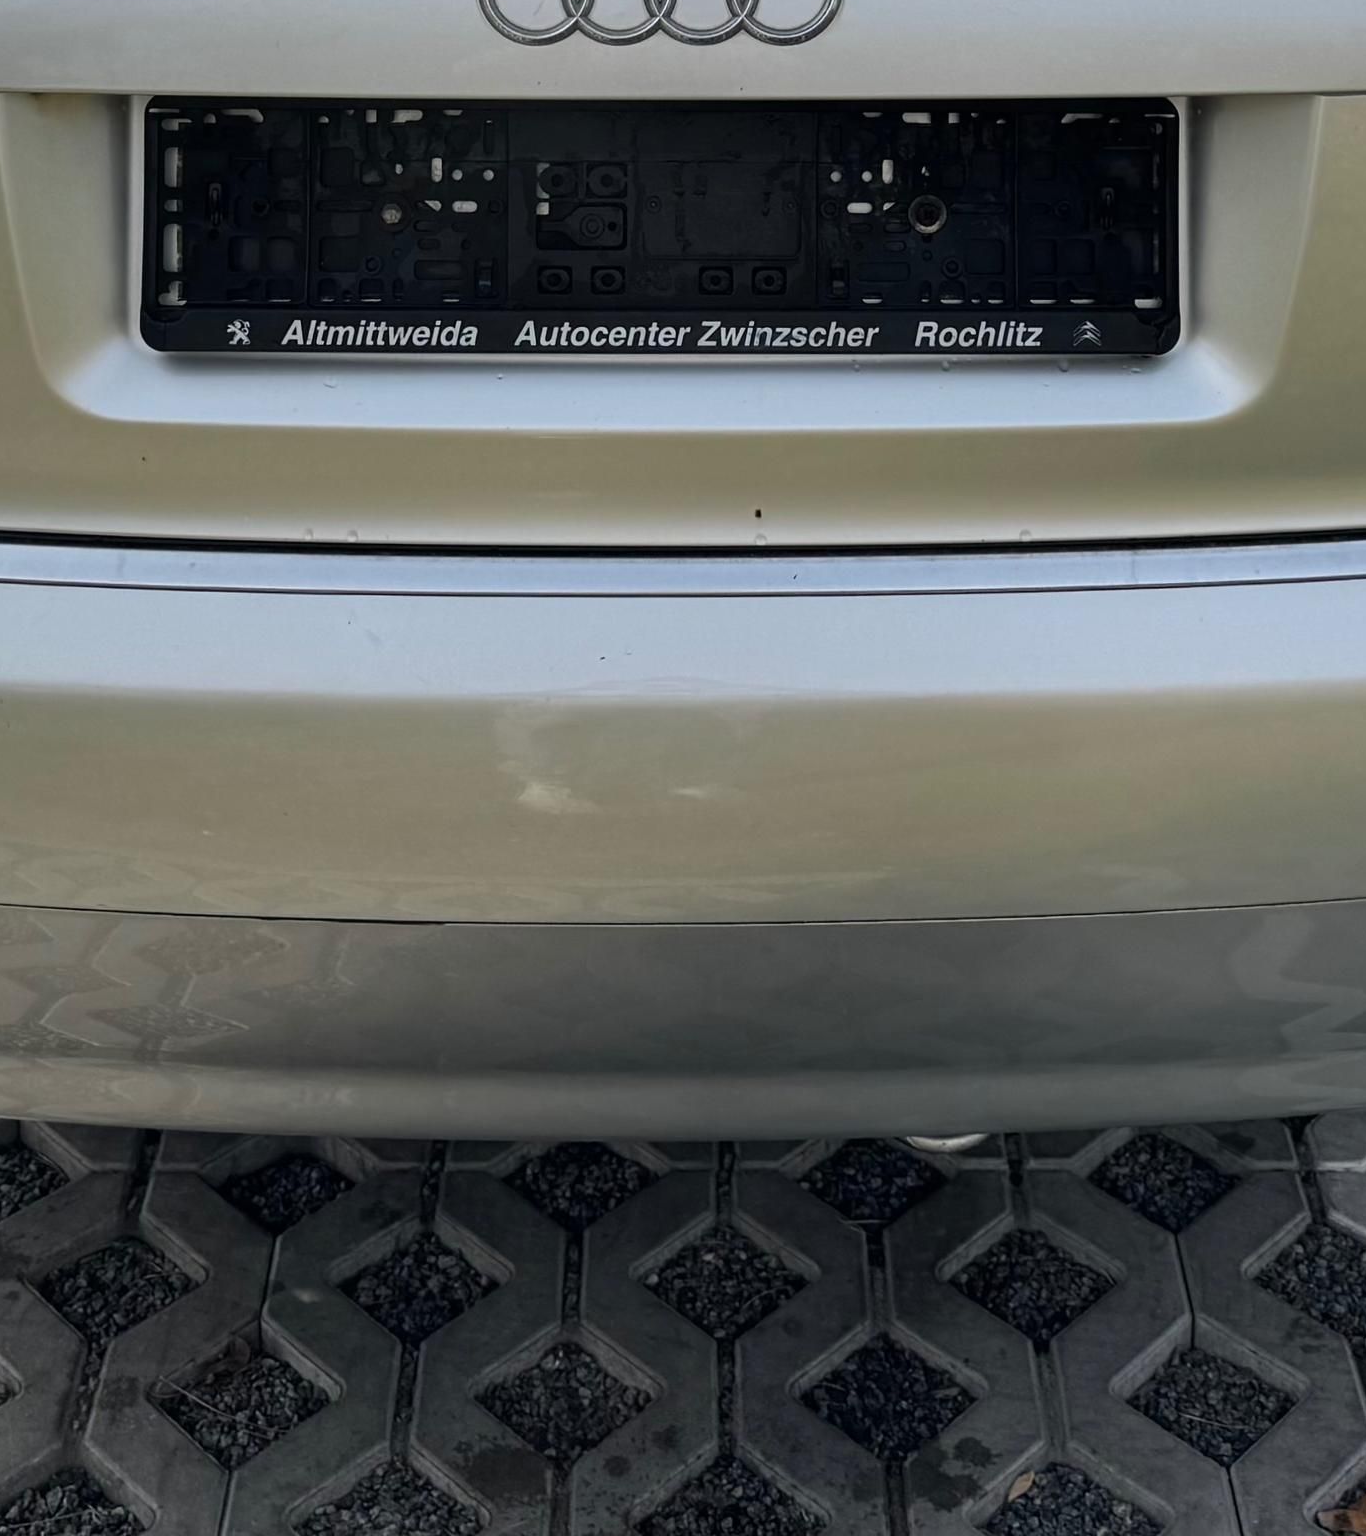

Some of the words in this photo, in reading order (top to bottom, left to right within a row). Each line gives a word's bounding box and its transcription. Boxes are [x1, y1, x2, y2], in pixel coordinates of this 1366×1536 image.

[281, 319, 478, 346] Altmittweida
[514, 320, 691, 346] Autocenter
[697, 320, 879, 346] Zwinzscher
[914, 320, 1043, 346] Rochlitz
